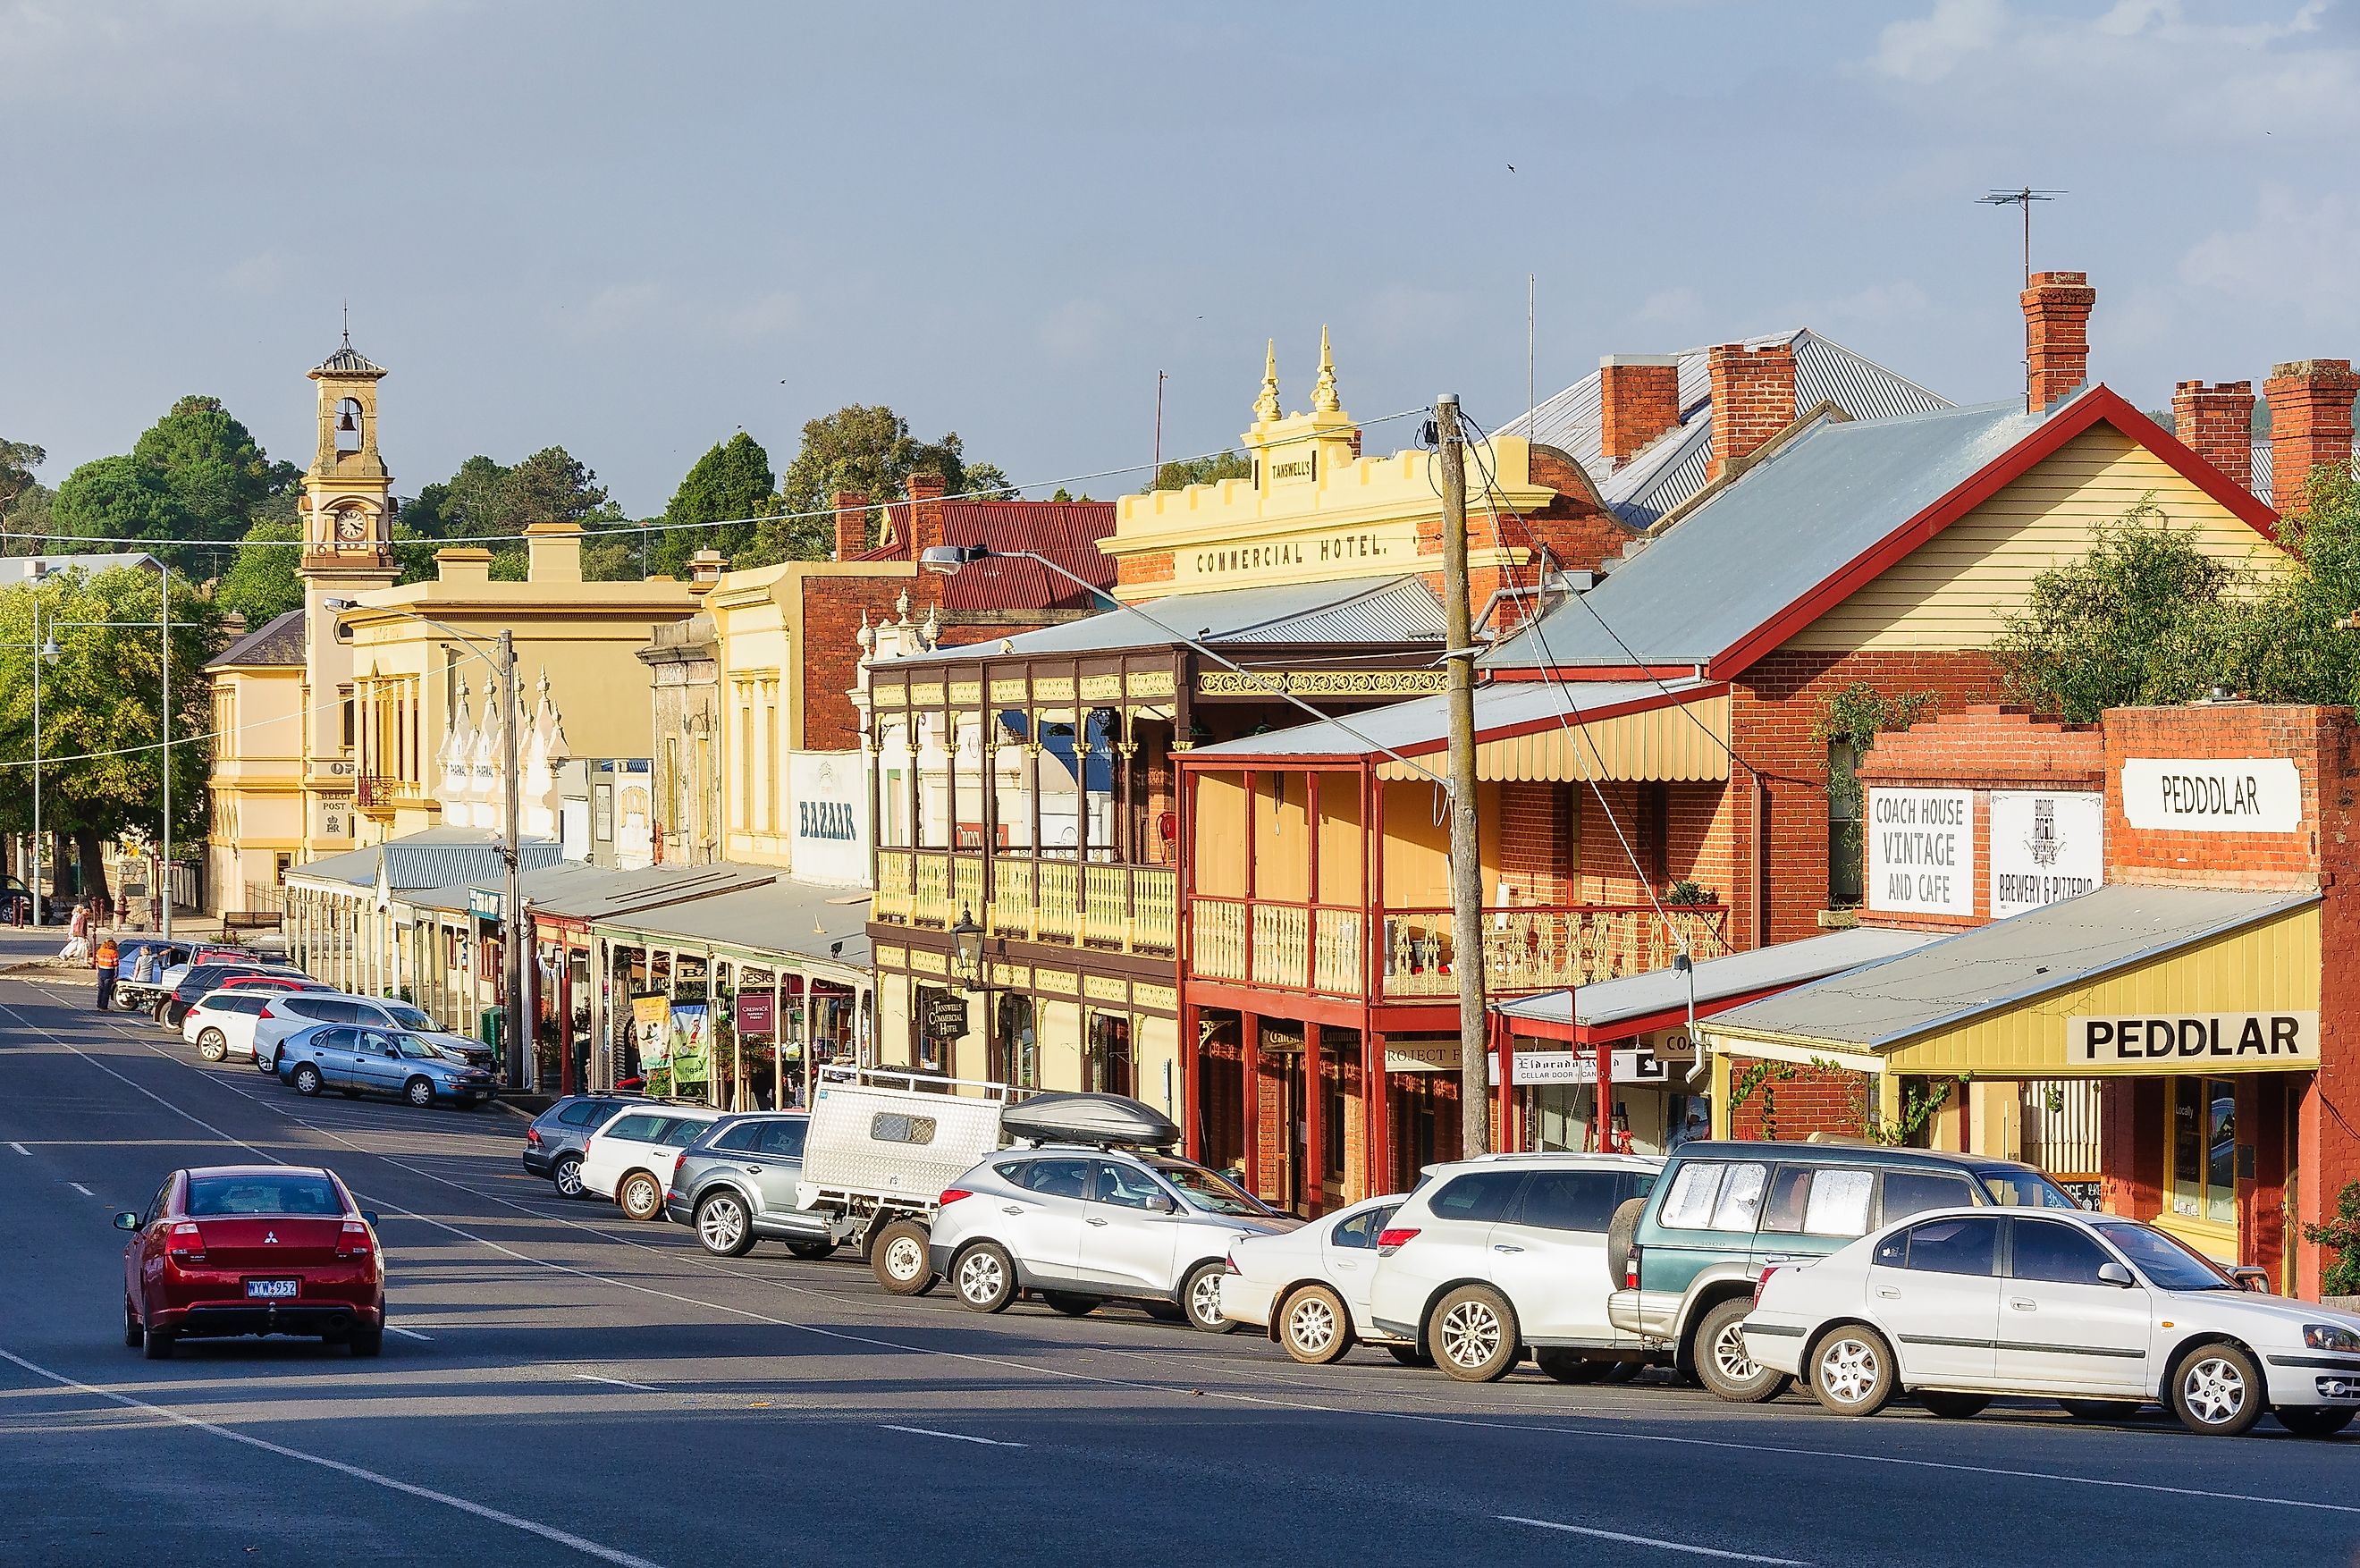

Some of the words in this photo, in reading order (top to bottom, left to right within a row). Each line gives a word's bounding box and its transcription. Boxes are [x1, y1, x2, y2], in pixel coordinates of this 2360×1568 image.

[1272, 460, 1311, 481] TANSWELL'S
[1197, 544, 1302, 573] COMMERCIAL
[2162, 775, 2261, 815] PEDDDLAR
[799, 801, 856, 841] BAZAAR
[1876, 797, 1916, 825] COACH
[1920, 798, 1964, 826] HOUSE
[1883, 831, 1956, 867] VINTAGE
[1888, 873, 1913, 901] AND
[1918, 873, 1951, 904] CAFE
[1999, 873, 2041, 904] BREWERY
[2044, 876, 2050, 904] &
[739, 971, 775, 983] DESIG
[940, 1022, 958, 1035] HOTEL
[2086, 1016, 2300, 1059] PEDDLAR
[1666, 1035, 1696, 1051] COA
[1387, 1049, 1446, 1062] ROJECT
[1513, 1057, 1579, 1070] Eldorado
[1521, 1071, 1550, 1080] CELLAR
[1552, 1070, 1573, 1079] DOOR
[2175, 1103, 2194, 1119] Locally
[248, 1281, 268, 1294] WYW
[276, 1281, 296, 1294] 952
